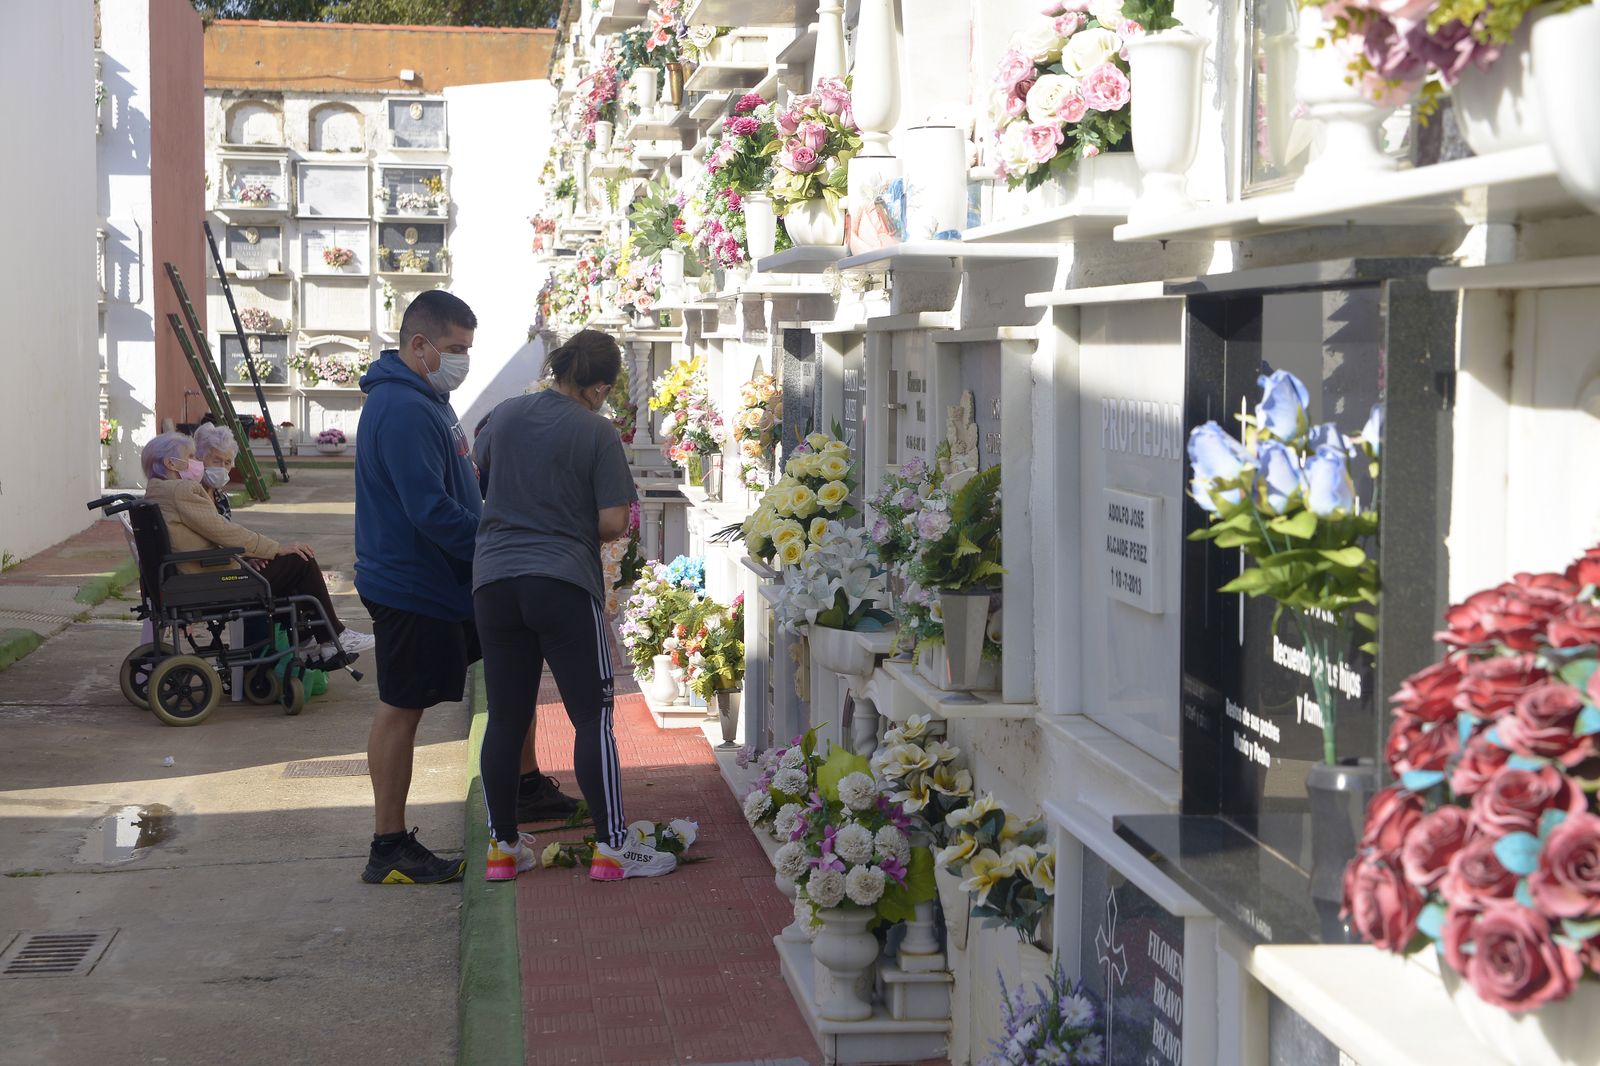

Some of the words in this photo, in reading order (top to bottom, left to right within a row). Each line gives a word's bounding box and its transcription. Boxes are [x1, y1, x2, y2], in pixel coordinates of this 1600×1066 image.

[1102, 398, 1181, 460] PROPIEDAD
[1108, 502, 1129, 526] ADOLFO
[1130, 508, 1144, 529] JOSE
[1106, 534, 1129, 558] ALCAIDE
[1129, 541, 1147, 564] PEREZ
[1339, 660, 1362, 700] hijos
[623, 851, 653, 863] GUESS
[1153, 975, 1182, 1026] BRAVO
[1152, 1016, 1181, 1066] BRAVO
